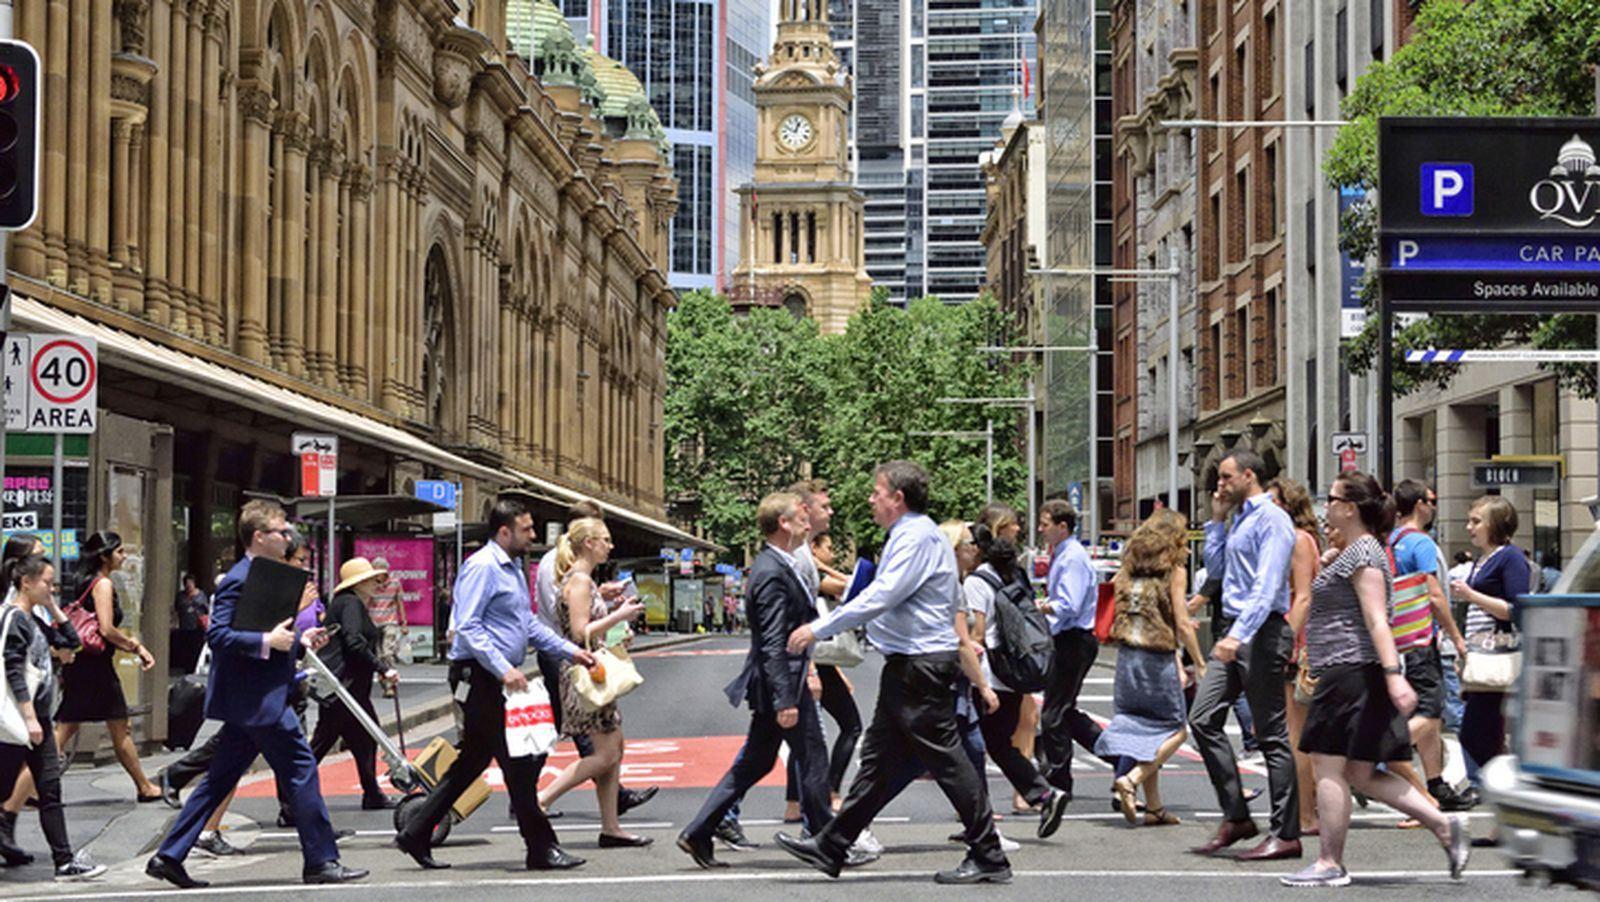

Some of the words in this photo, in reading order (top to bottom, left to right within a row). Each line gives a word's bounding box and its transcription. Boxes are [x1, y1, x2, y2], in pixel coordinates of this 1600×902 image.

[1434, 169, 1464, 209] P
[1529, 179, 1600, 228] QV
[1398, 240, 1419, 267] P
[1519, 245, 1564, 262] CAR
[1574, 245, 1600, 262] PA
[1473, 280, 1528, 298] Spaces
[1531, 281, 1599, 297] Available
[39, 357, 87, 387] 40
[32, 408, 94, 427] AREA
